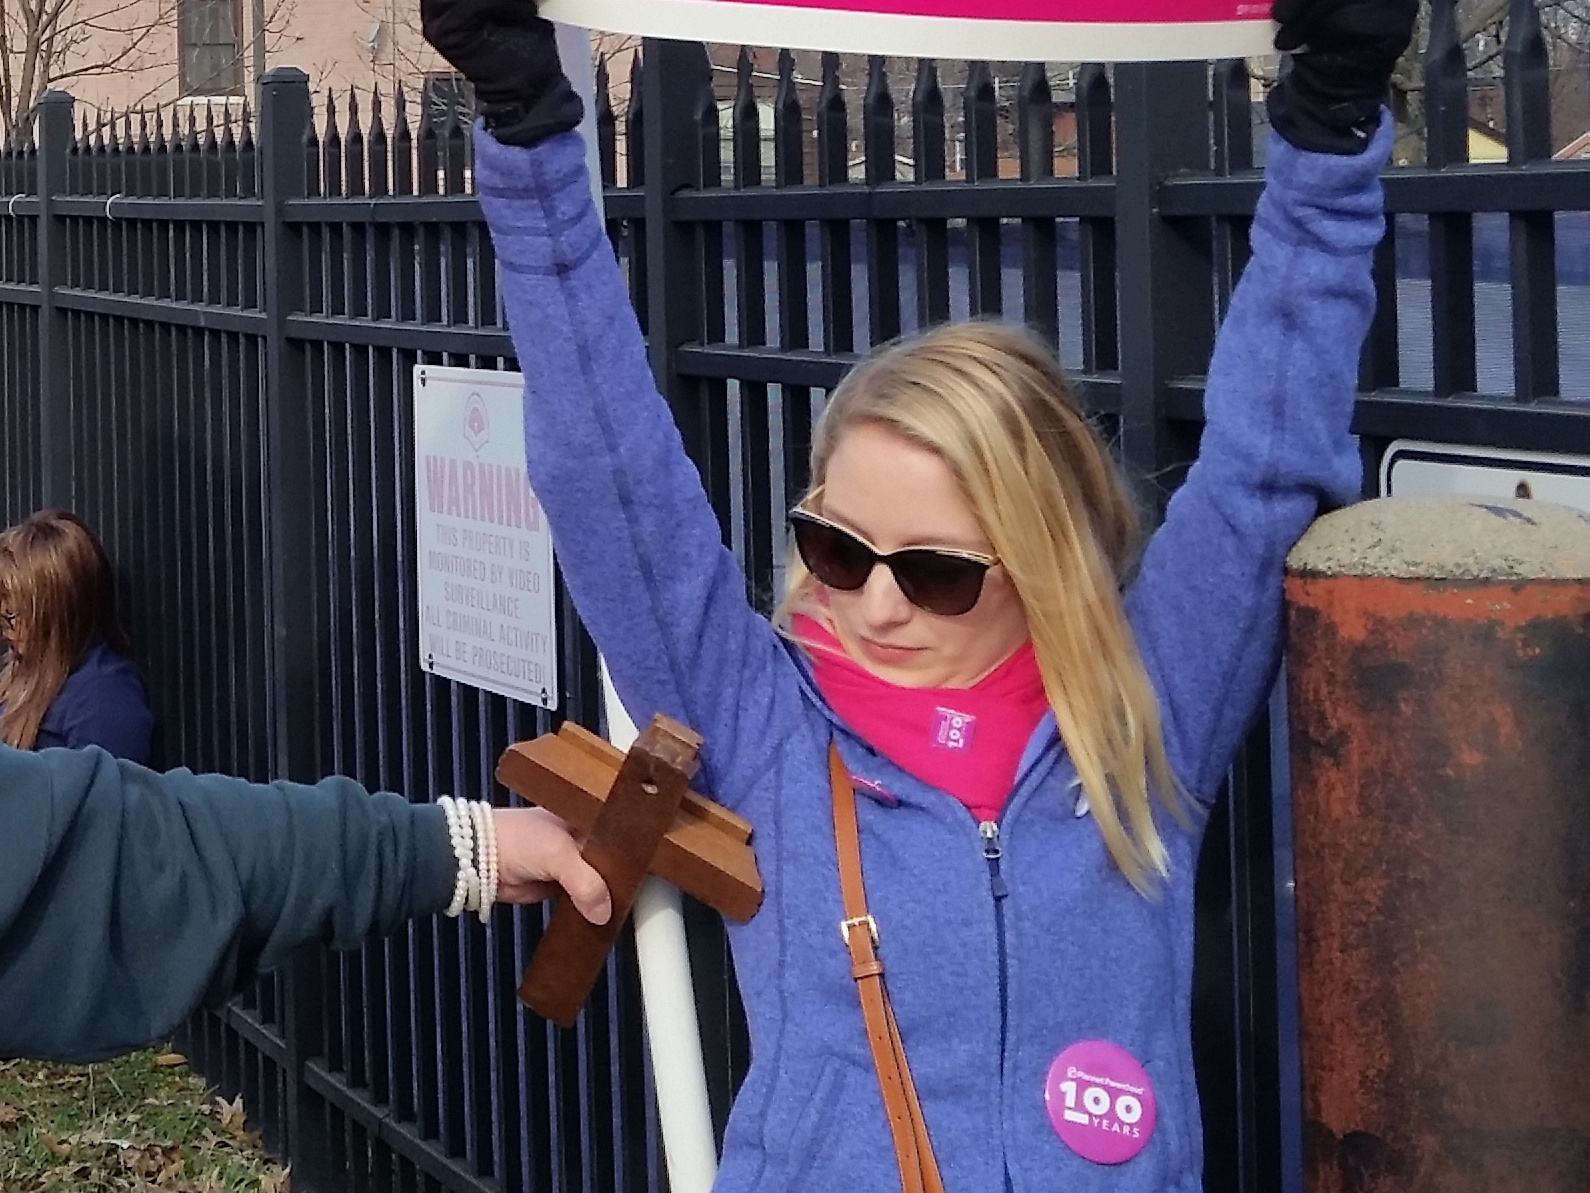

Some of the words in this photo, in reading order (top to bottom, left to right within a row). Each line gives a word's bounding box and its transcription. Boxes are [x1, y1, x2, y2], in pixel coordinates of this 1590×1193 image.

[435, 523, 459, 548] THIS
[462, 528, 514, 559] PROPERTY
[519, 538, 531, 562] IS
[428, 550, 487, 582] MONITORED
[507, 567, 541, 594] VIDEO
[444, 581, 520, 620] SURVEILLANCE
[498, 623, 548, 654] ACTIVITY
[1059, 1081, 1143, 1125] 100
[1092, 1116, 1141, 1139] YEARS
